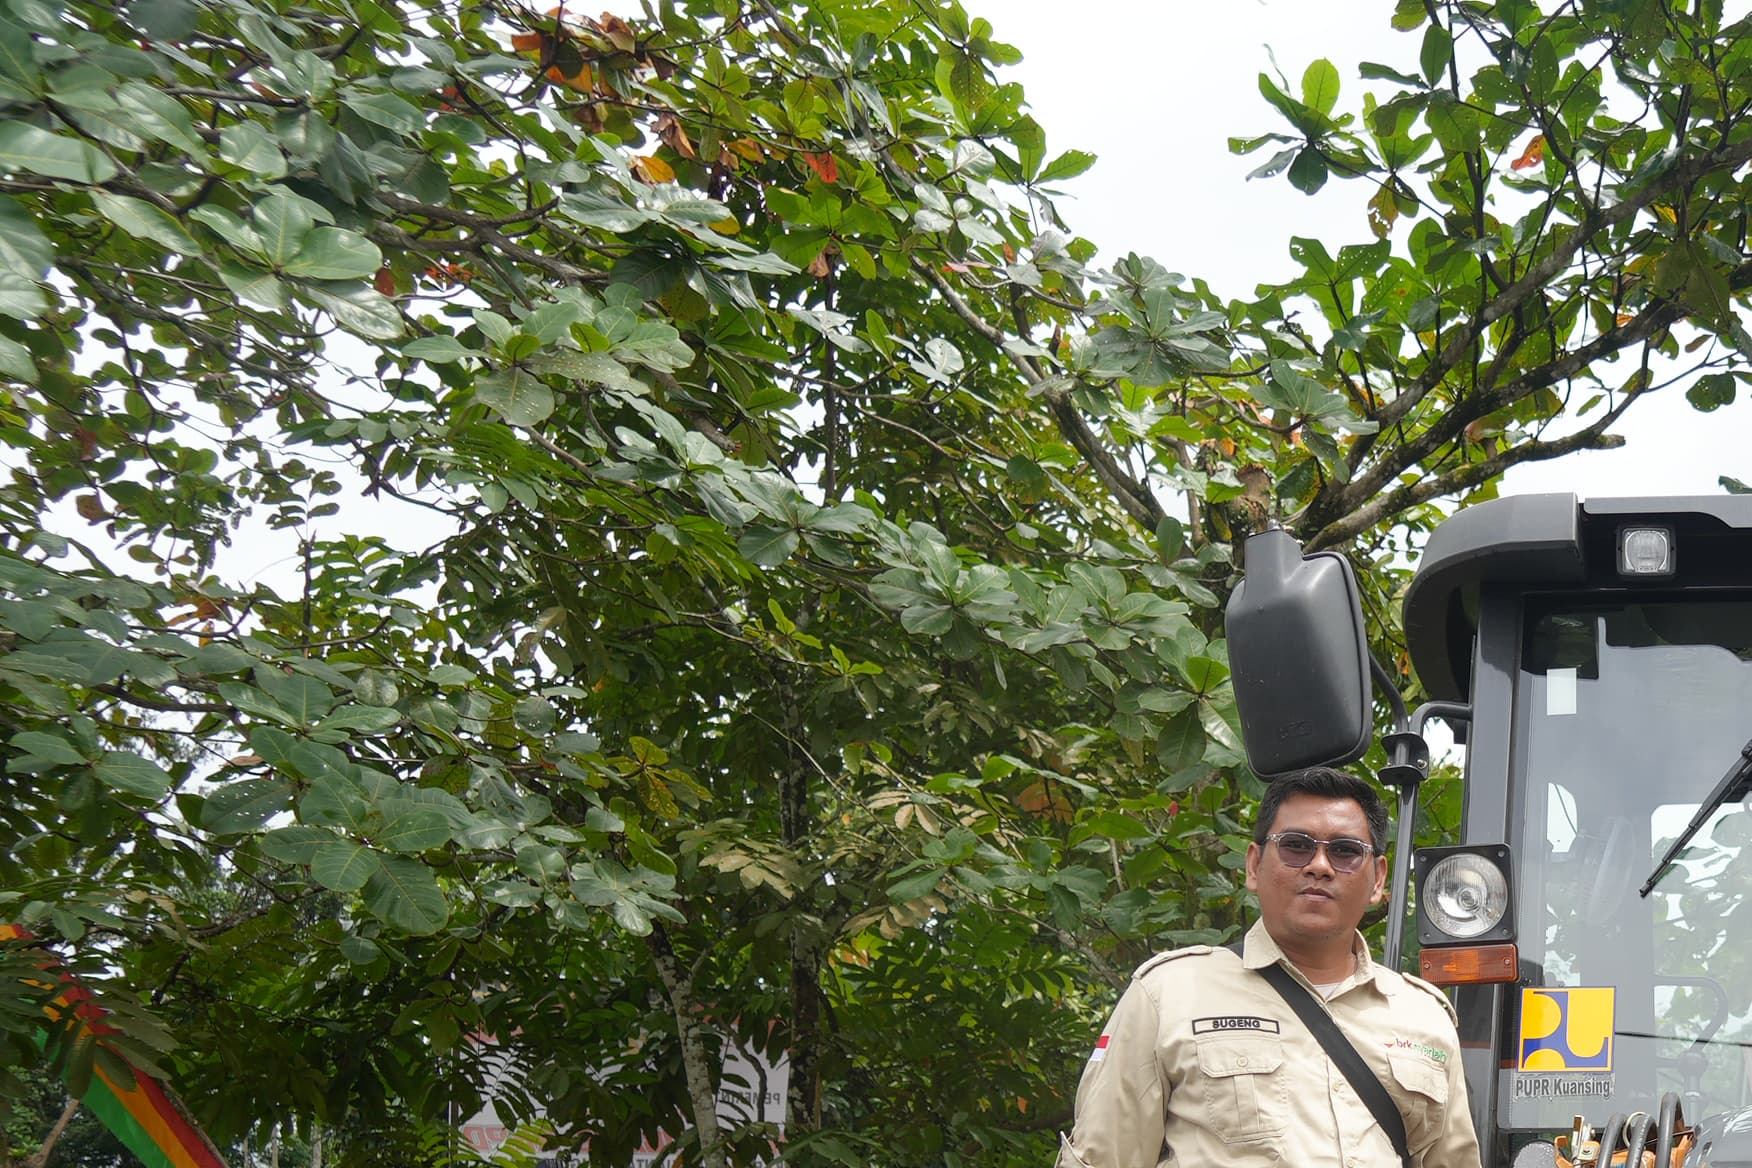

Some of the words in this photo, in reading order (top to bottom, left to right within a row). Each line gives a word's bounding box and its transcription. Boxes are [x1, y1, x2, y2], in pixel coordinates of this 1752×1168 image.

[1212, 1018, 1261, 1029] SUGENG
[1516, 1077, 1550, 1097] PUPR
[1553, 1076, 1611, 1100] Kuansing
